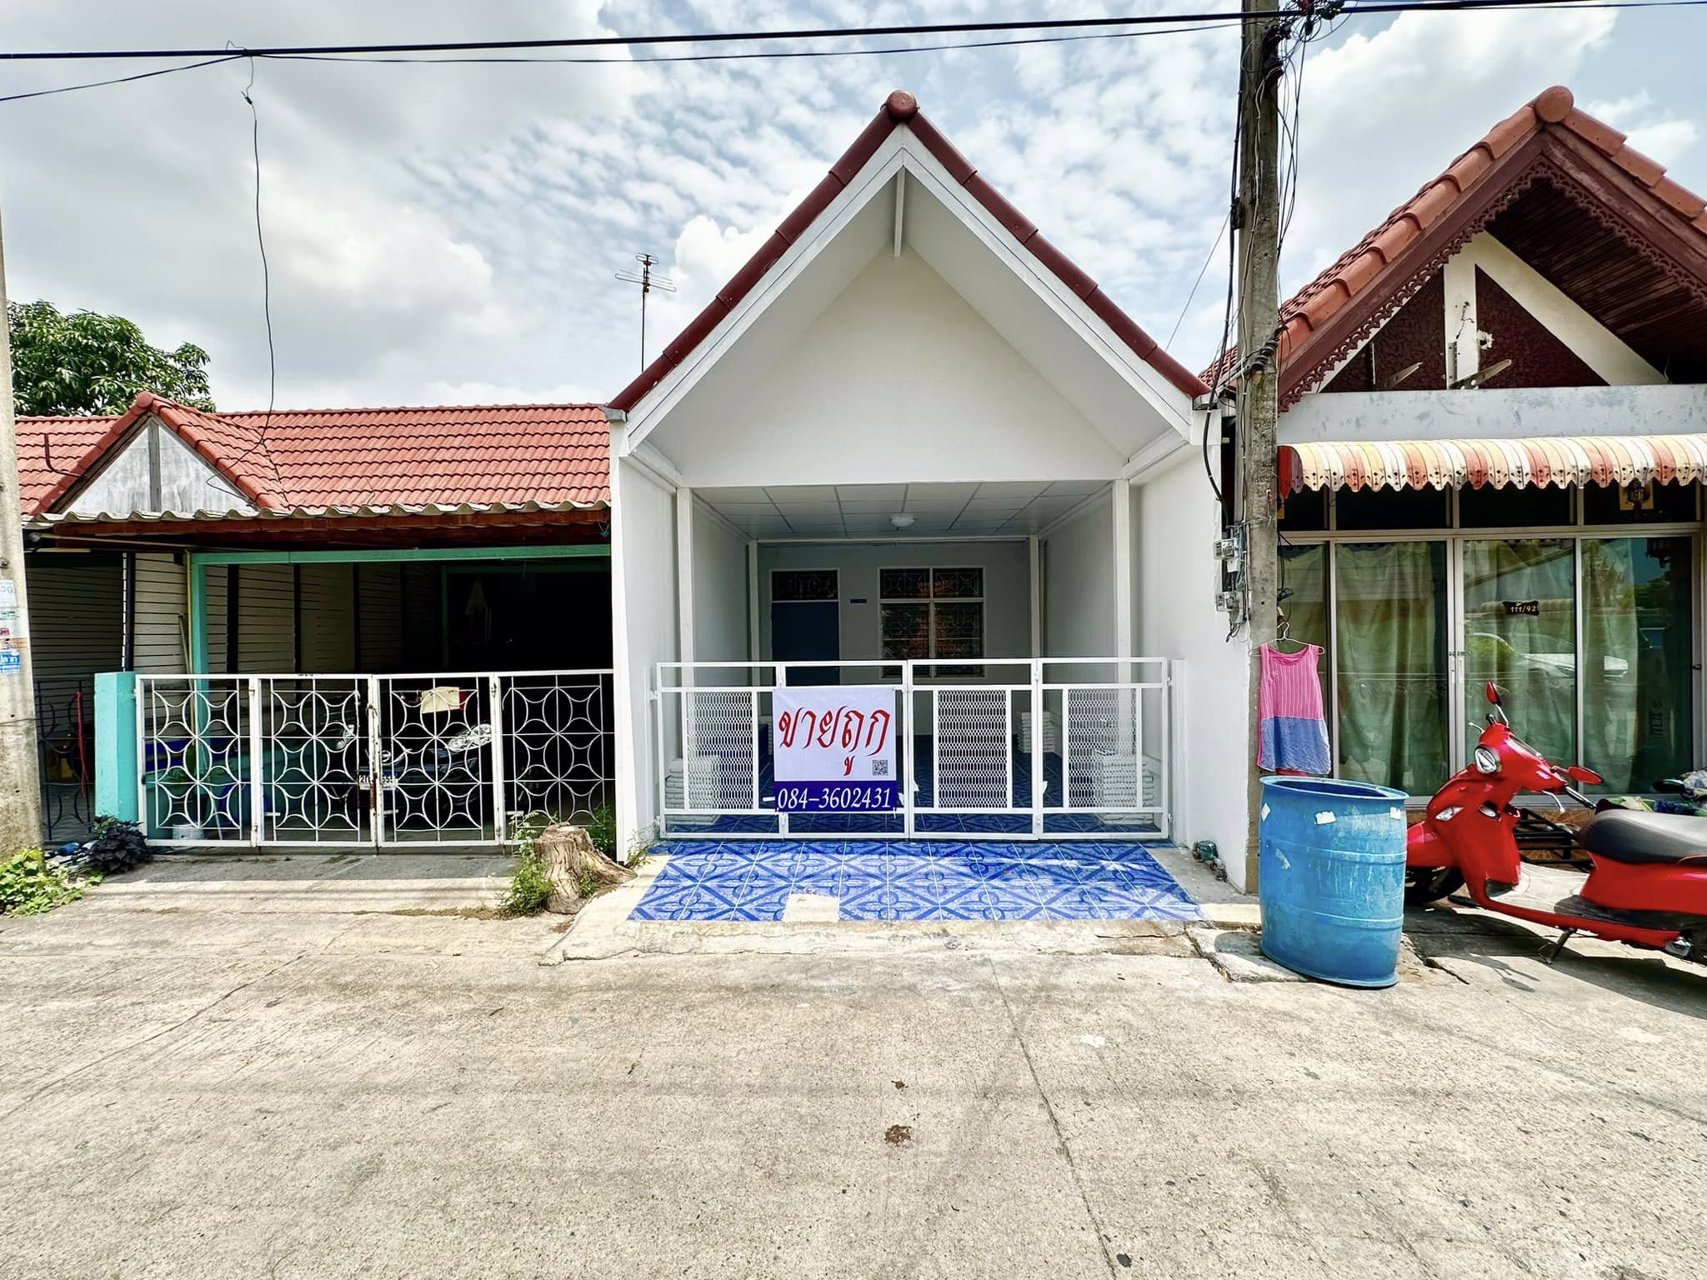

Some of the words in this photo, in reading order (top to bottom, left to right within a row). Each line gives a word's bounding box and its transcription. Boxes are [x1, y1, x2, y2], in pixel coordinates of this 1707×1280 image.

[778, 705, 891, 776] ขายถูก
[777, 787, 891, 809] 084-3602431
